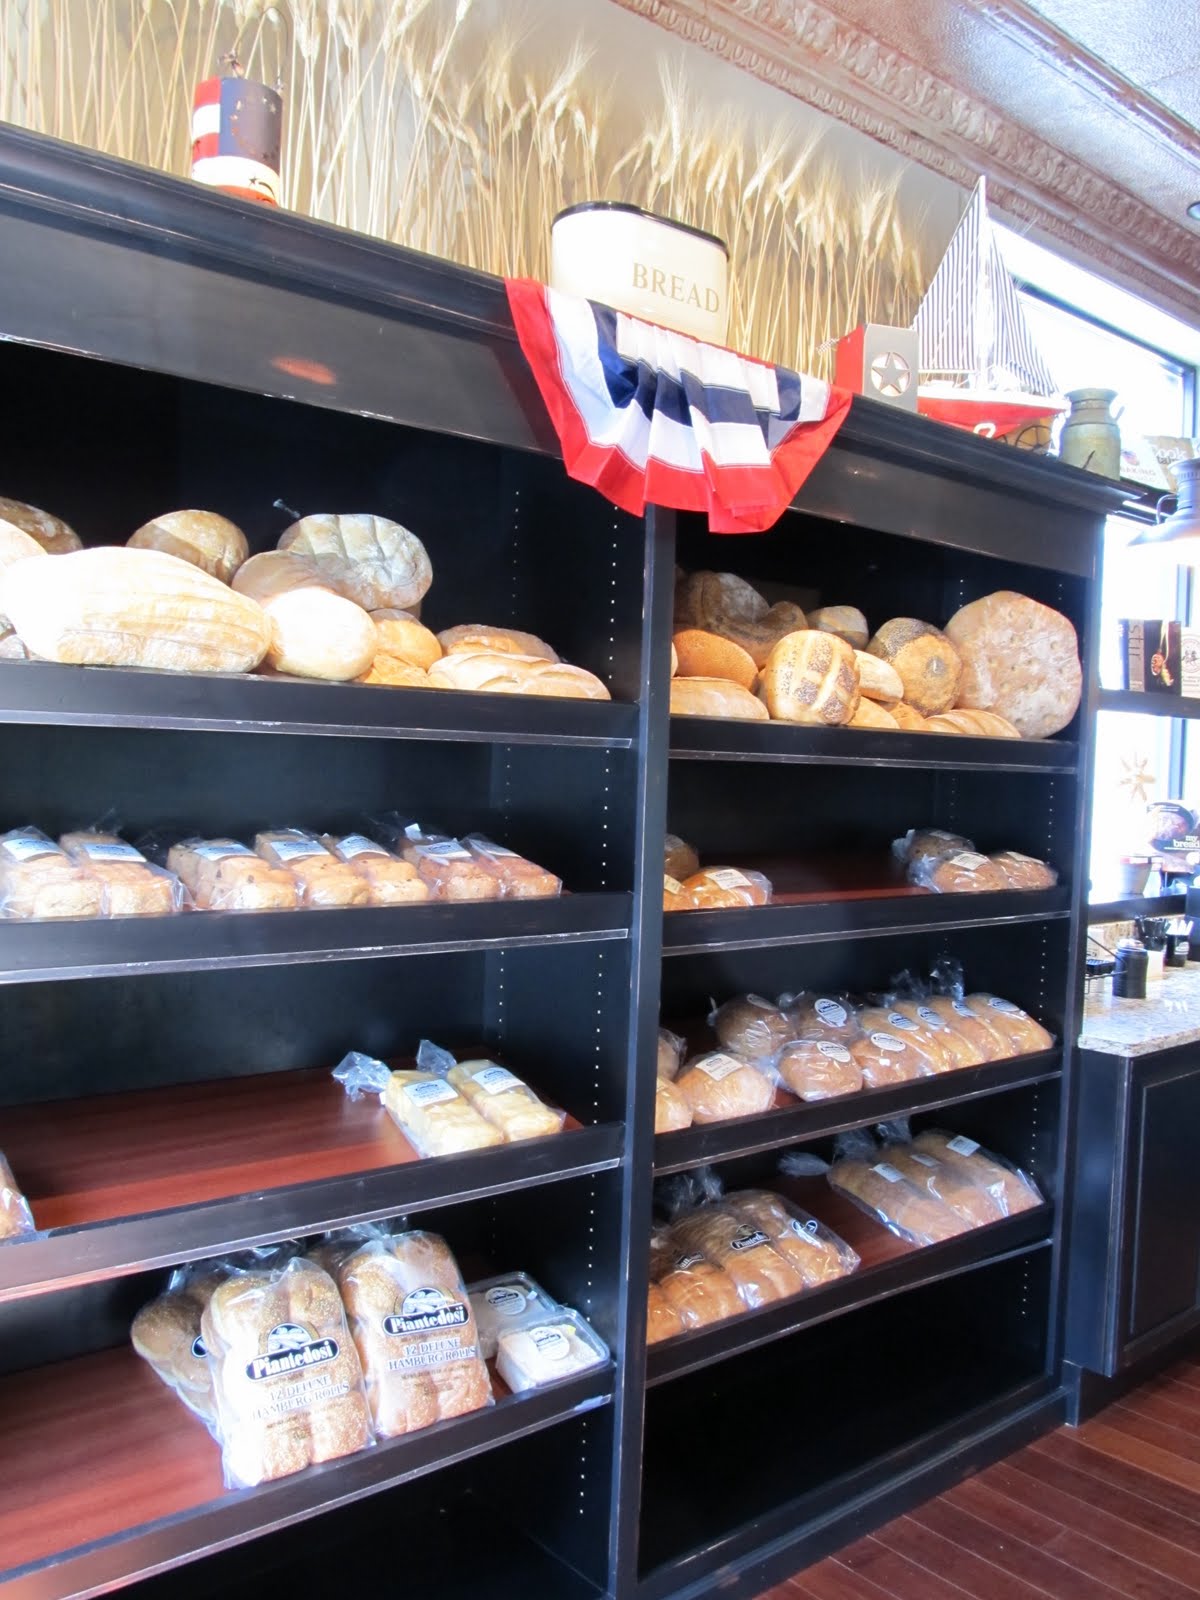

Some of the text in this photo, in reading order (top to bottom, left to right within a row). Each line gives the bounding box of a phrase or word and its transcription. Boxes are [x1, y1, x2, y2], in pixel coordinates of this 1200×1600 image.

[632, 262, 720, 314] BREAD
[1173, 838, 1200, 848] bread
[390, 1305, 465, 1333] Piantedosi
[252, 1340, 334, 1379] Piantedosi
[389, 1346, 478, 1370] HAMBURG ROLLS
[406, 1338, 459, 1355] 12 DELUXE
[270, 1389, 283, 1401] 12
[287, 1375, 330, 1396] DELUXE
